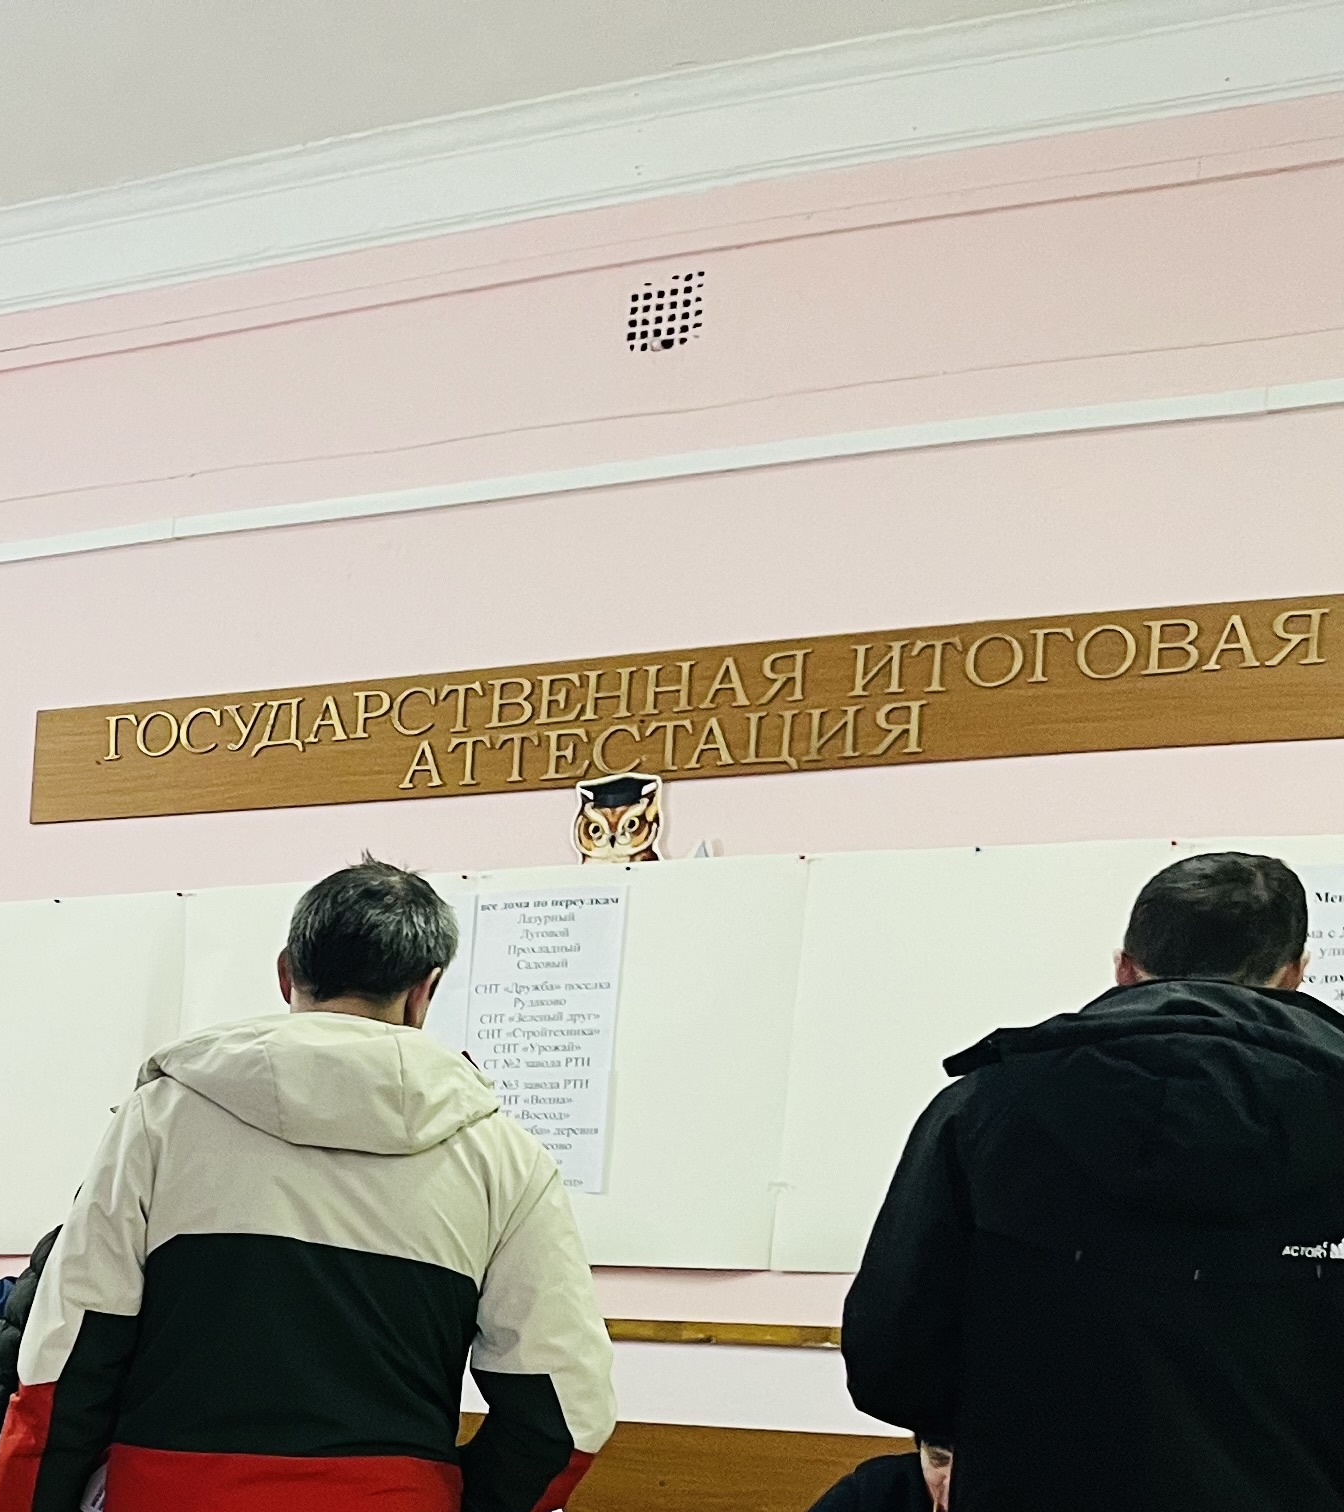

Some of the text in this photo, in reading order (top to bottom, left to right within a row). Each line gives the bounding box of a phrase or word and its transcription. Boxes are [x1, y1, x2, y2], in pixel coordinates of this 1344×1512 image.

[103, 608, 1330, 761] ГОСУДАРСТВЕННАЯ ИТОГОВАЯ
[398, 700, 929, 790] АТТЕСТАЦИЯ
[551, 897, 619, 909] переулкам
[516, 958, 568, 970] Садовый
